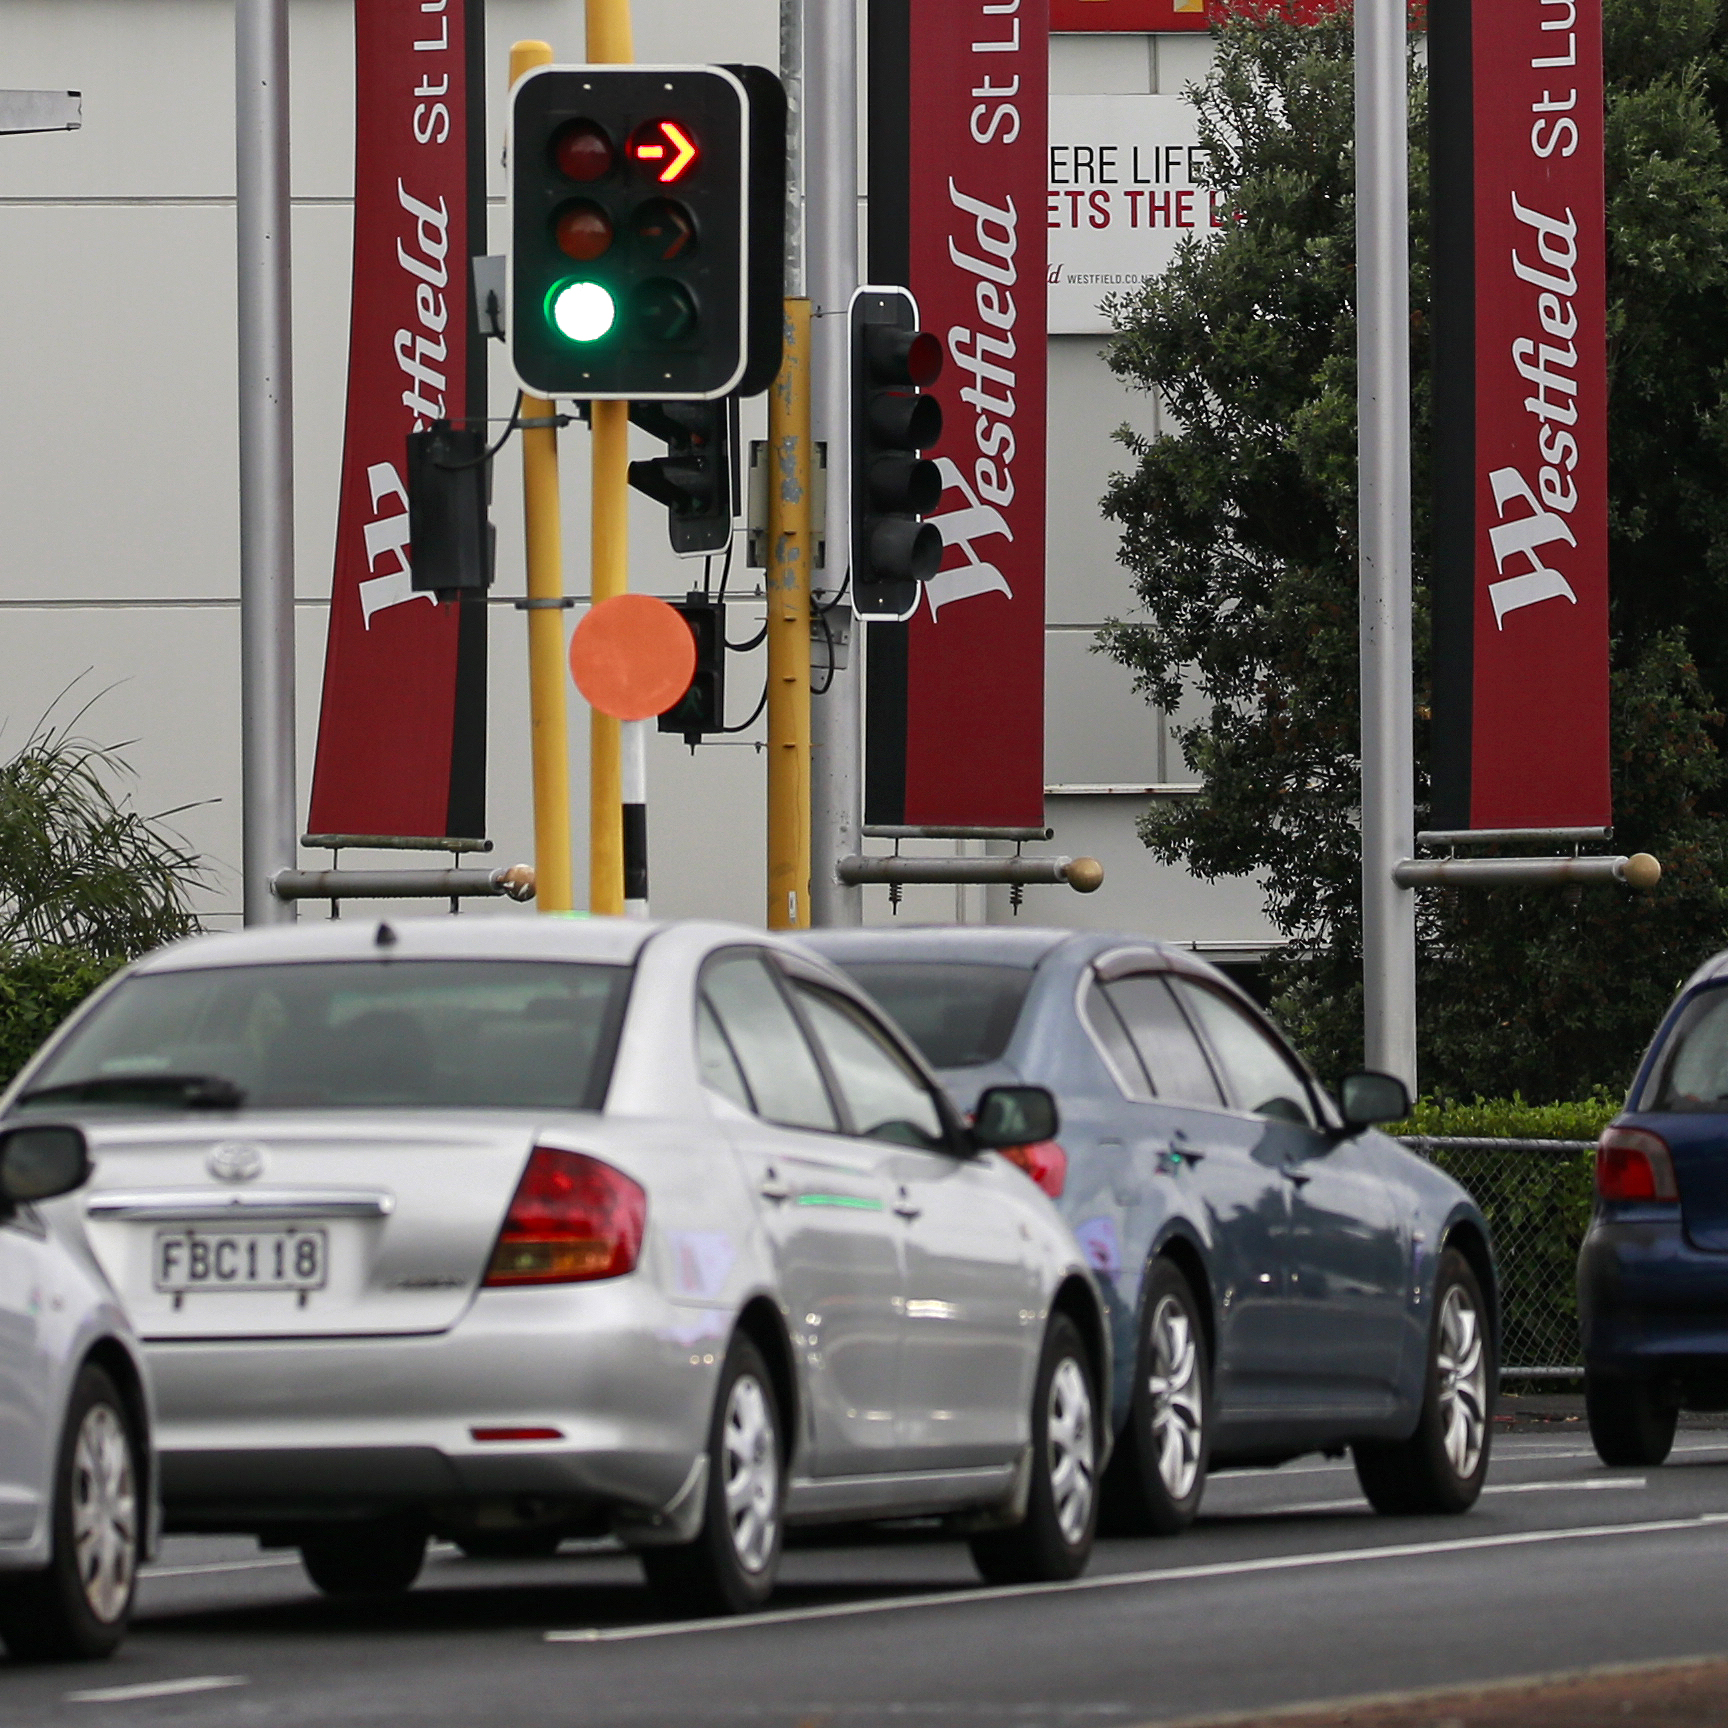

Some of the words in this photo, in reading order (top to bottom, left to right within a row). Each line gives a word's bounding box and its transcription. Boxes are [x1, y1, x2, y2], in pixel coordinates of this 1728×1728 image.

[970, 75, 1021, 144] St
[1531, 89, 1579, 158] St
[1050, 146, 1119, 184] ERE
[1133, 146, 1210, 184] LIFE
[1047, 190, 1111, 229] ETS
[1124, 190, 1195, 228] THE
[359, 177, 450, 631] Wtfield
[413, 74, 450, 144] St
[925, 175, 1020, 624] Westfield
[1488, 190, 1579, 632] Westfield
[161, 1238, 318, 1282] FBC118
